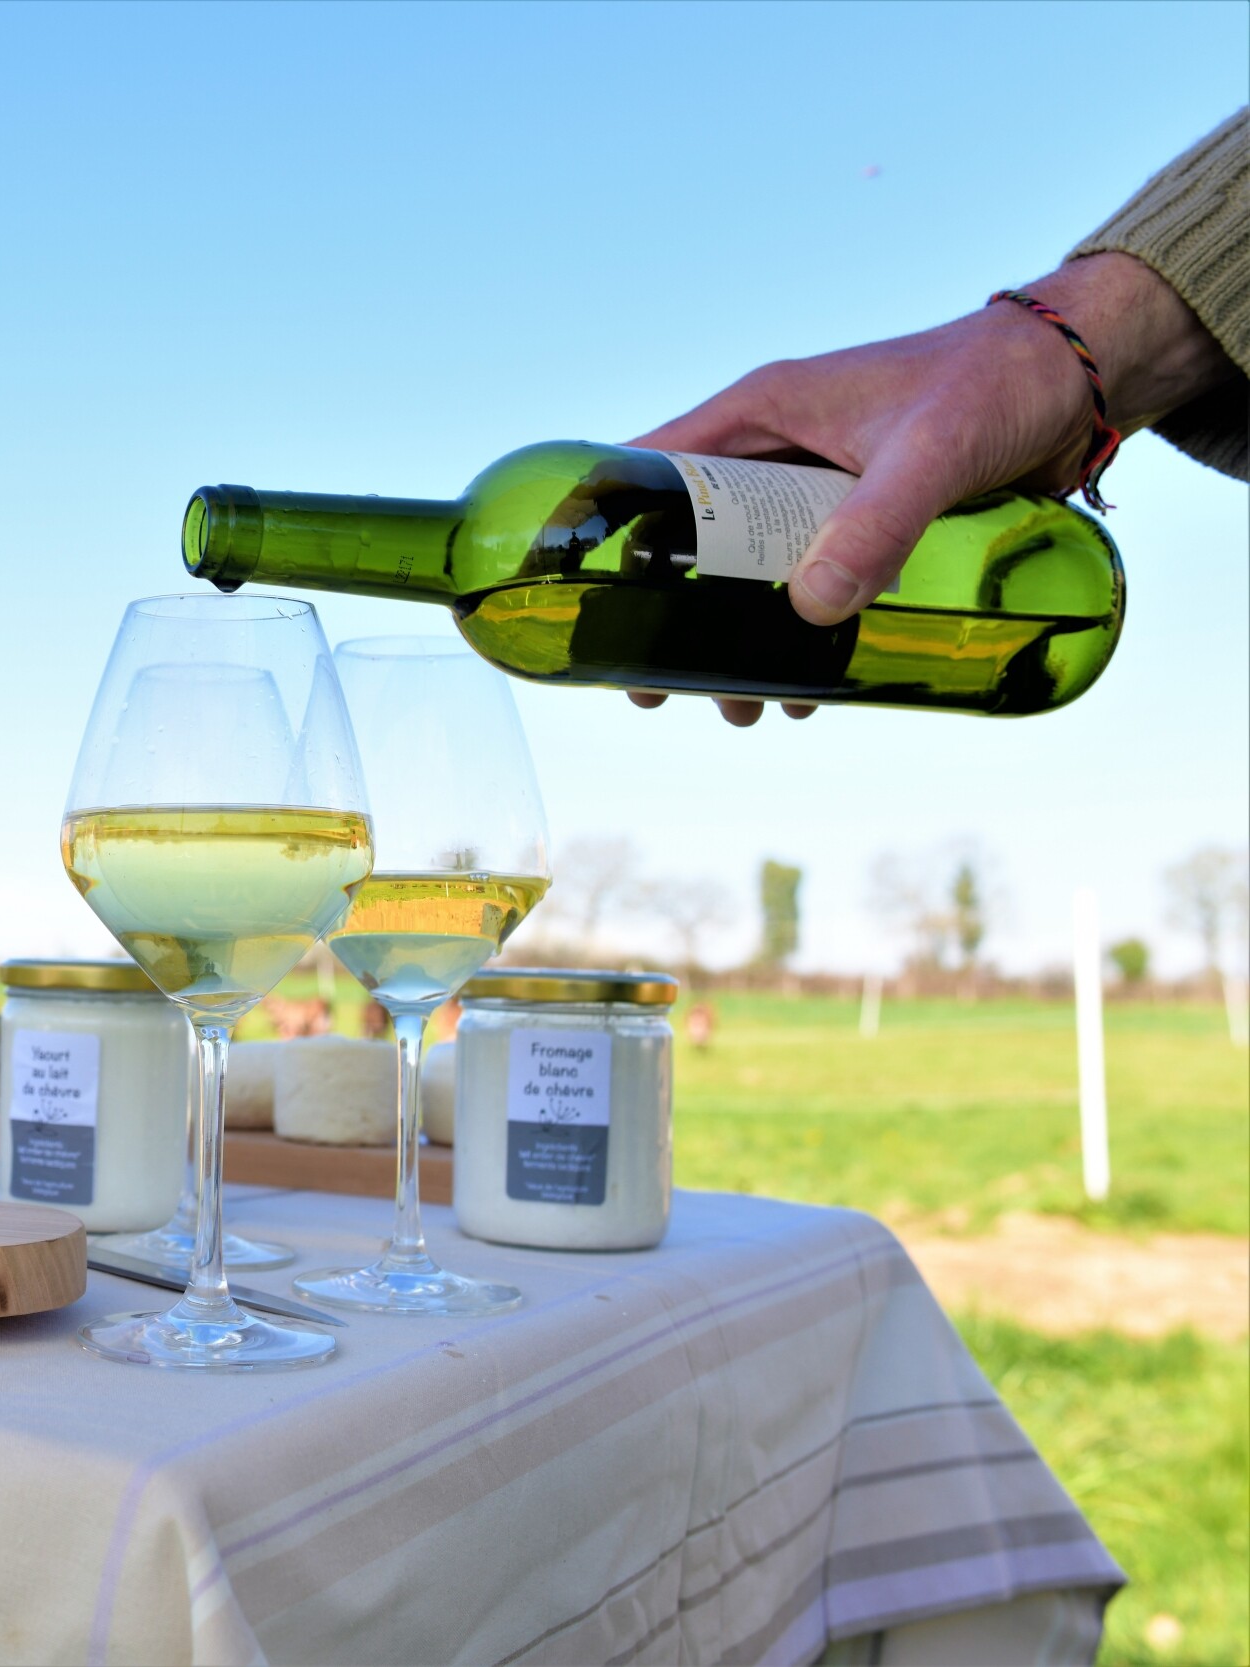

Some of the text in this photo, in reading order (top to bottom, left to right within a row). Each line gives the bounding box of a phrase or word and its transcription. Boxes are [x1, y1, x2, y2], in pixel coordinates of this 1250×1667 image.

[694, 478, 711, 505] Pinot
[701, 506, 716, 521] Le
[742, 504, 752, 523] nous
[788, 508, 799, 527] nous
[746, 524, 755, 536] de
[754, 521, 763, 529] la
[772, 518, 781, 526] la
[747, 537, 755, 553] Qui
[756, 538, 765, 566] Reliés
[784, 541, 792, 566] Leurs
[31, 1045, 70, 1061] Yaourt
[531, 1042, 593, 1063] Fromage
[32, 1064, 68, 1079] au lait
[538, 1062, 579, 1078] blanc
[22, 1081, 35, 1095] de
[523, 1081, 540, 1096] de
